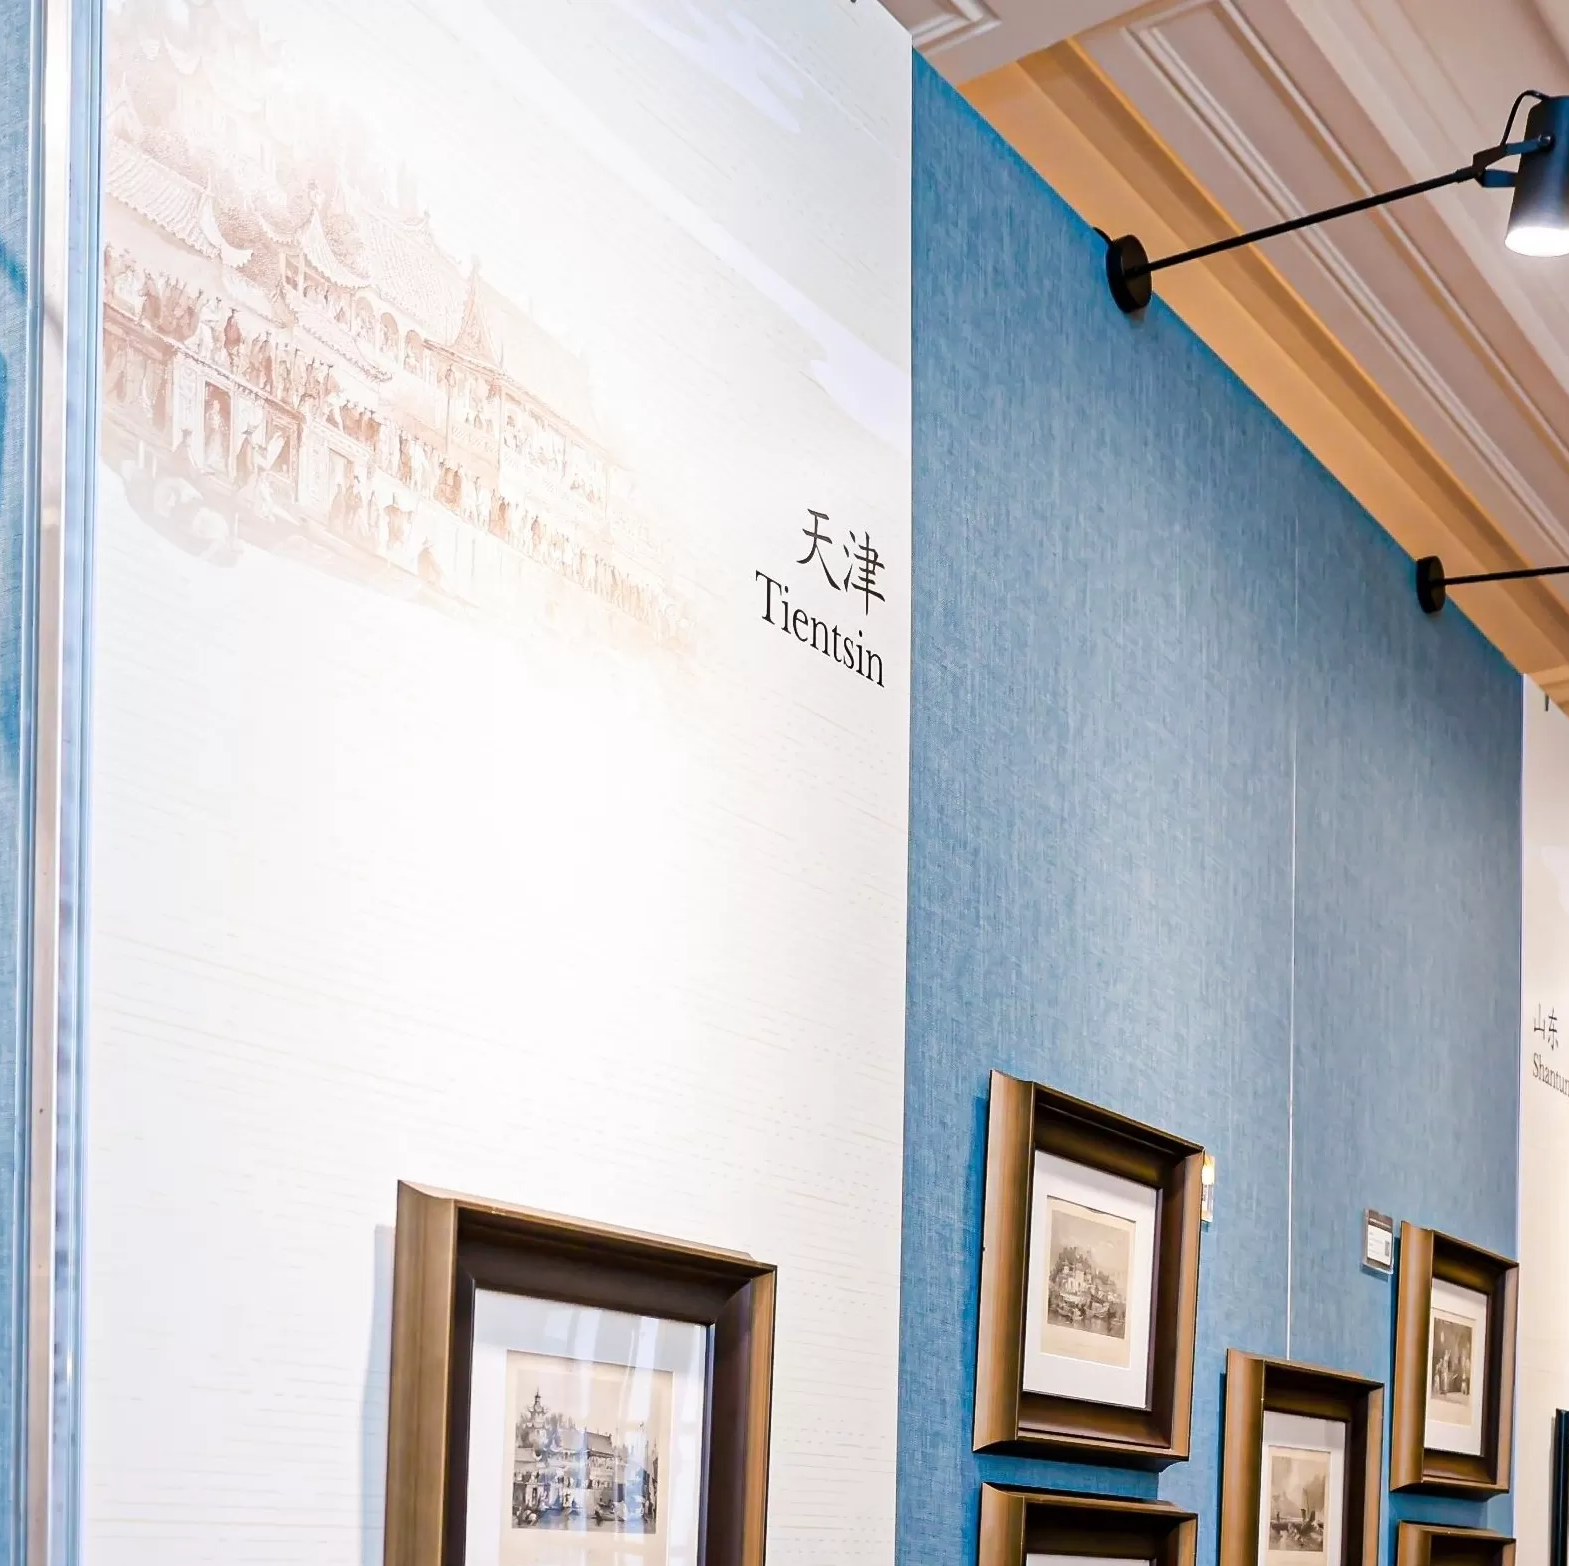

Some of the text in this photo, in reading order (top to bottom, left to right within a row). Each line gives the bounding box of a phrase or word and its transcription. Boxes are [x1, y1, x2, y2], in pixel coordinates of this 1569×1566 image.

[797, 508, 885, 616] 天津
[755, 569, 884, 688] Tientsin
[1533, 1002, 1559, 1051] 山东
